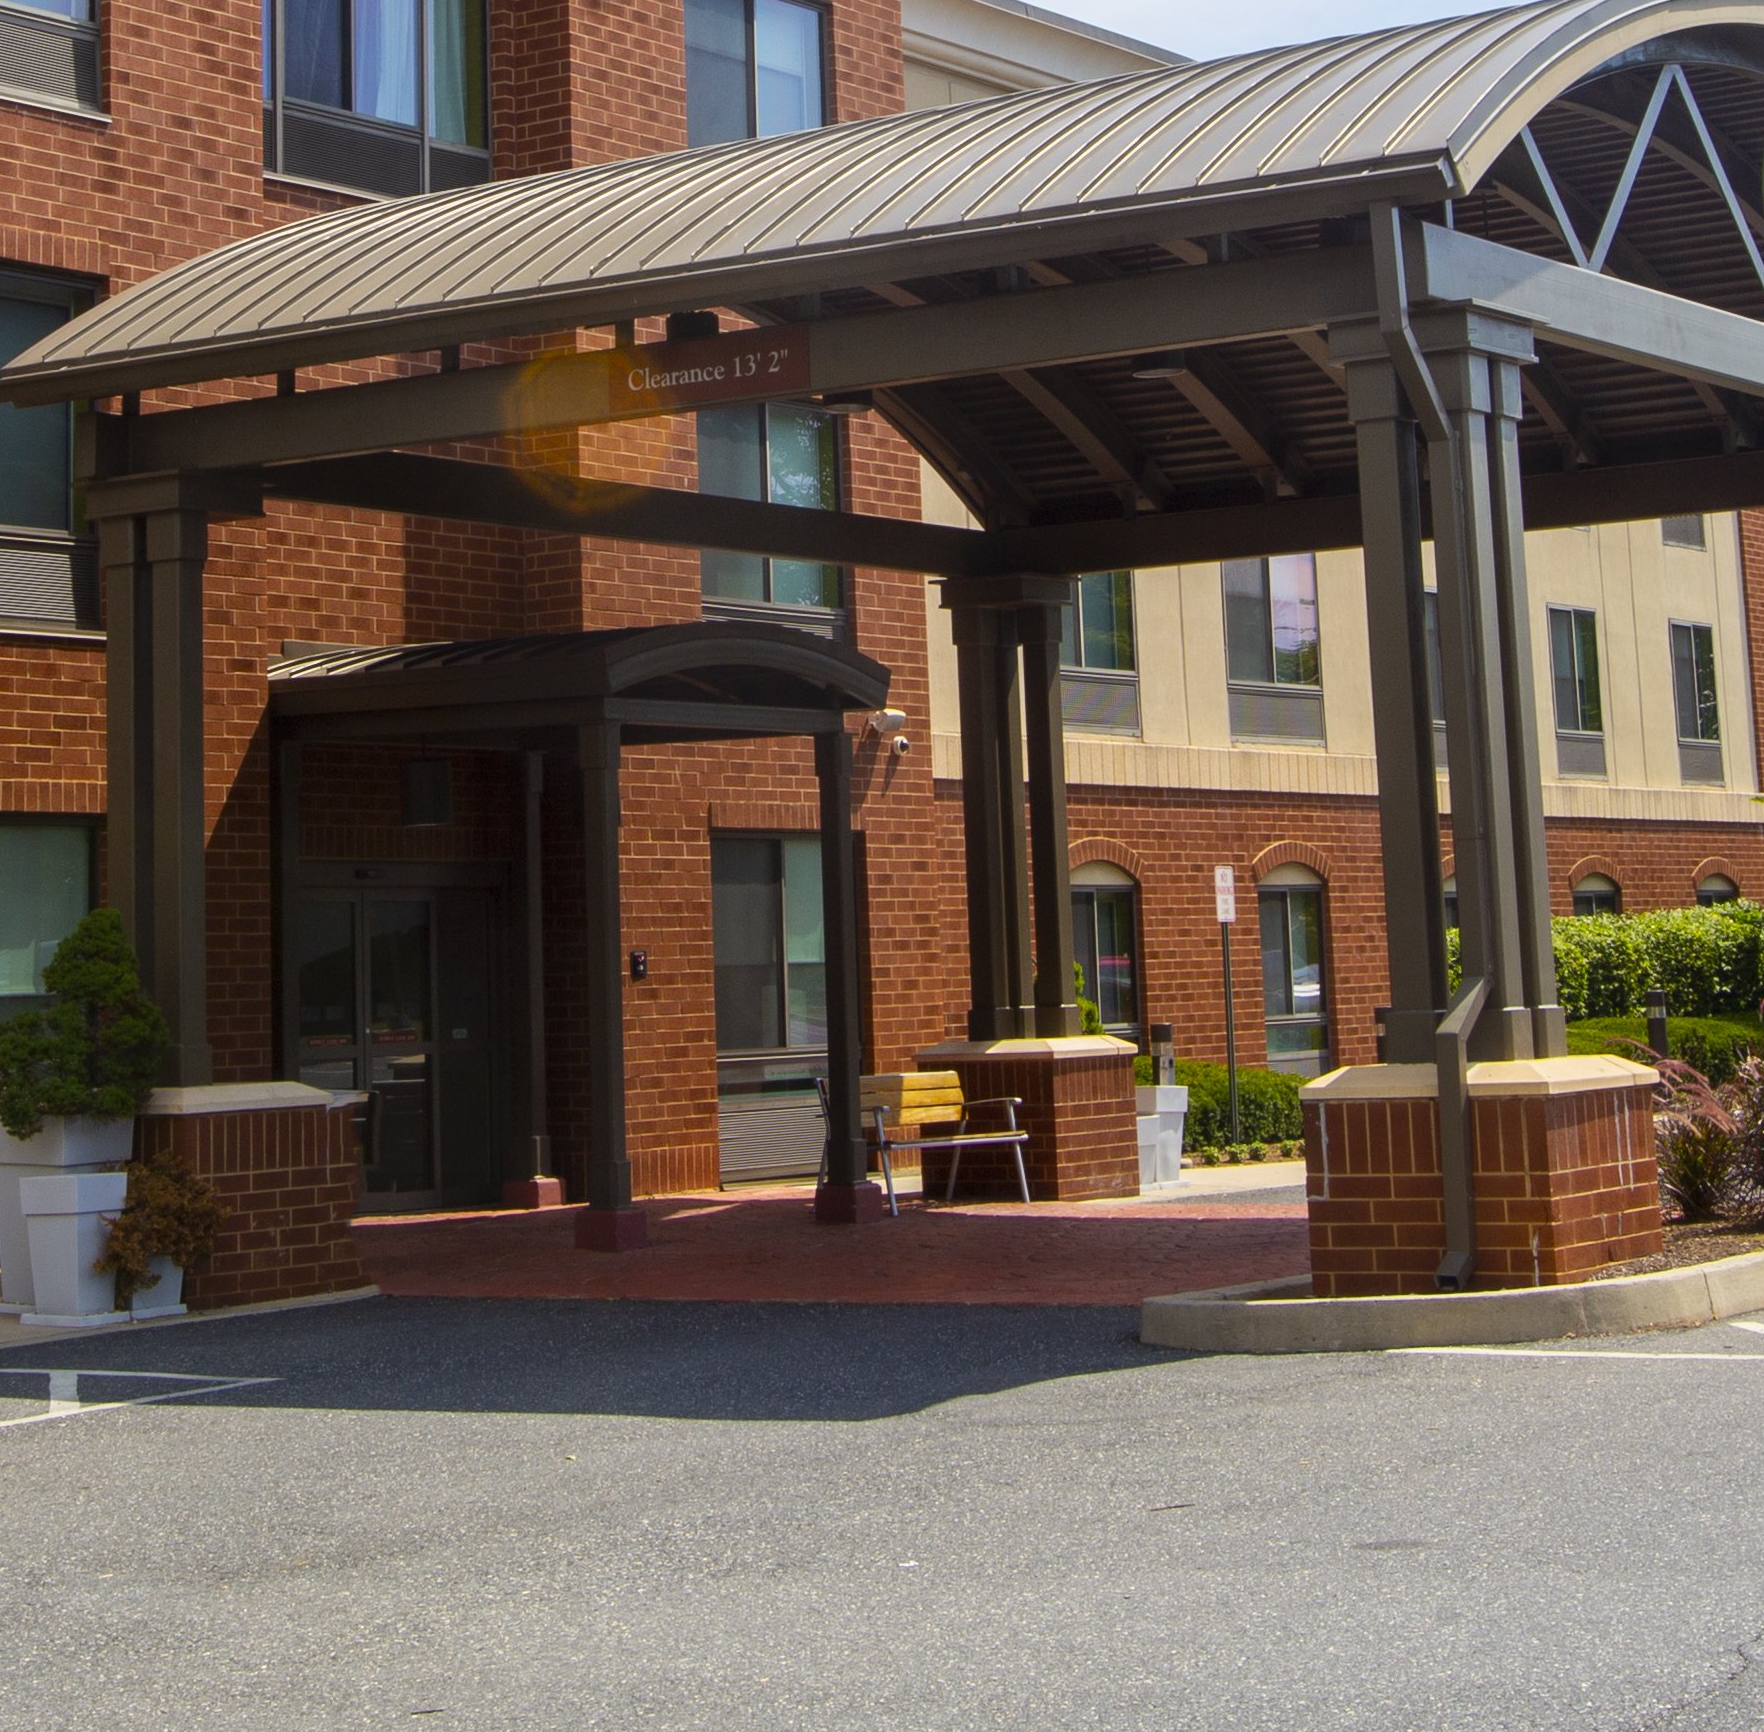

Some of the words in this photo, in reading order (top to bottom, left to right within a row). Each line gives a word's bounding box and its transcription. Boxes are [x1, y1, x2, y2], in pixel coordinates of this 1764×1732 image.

[627, 364, 726, 391] Clearance
[733, 352, 762, 377] 13'
[768, 348, 789, 373] 2"
